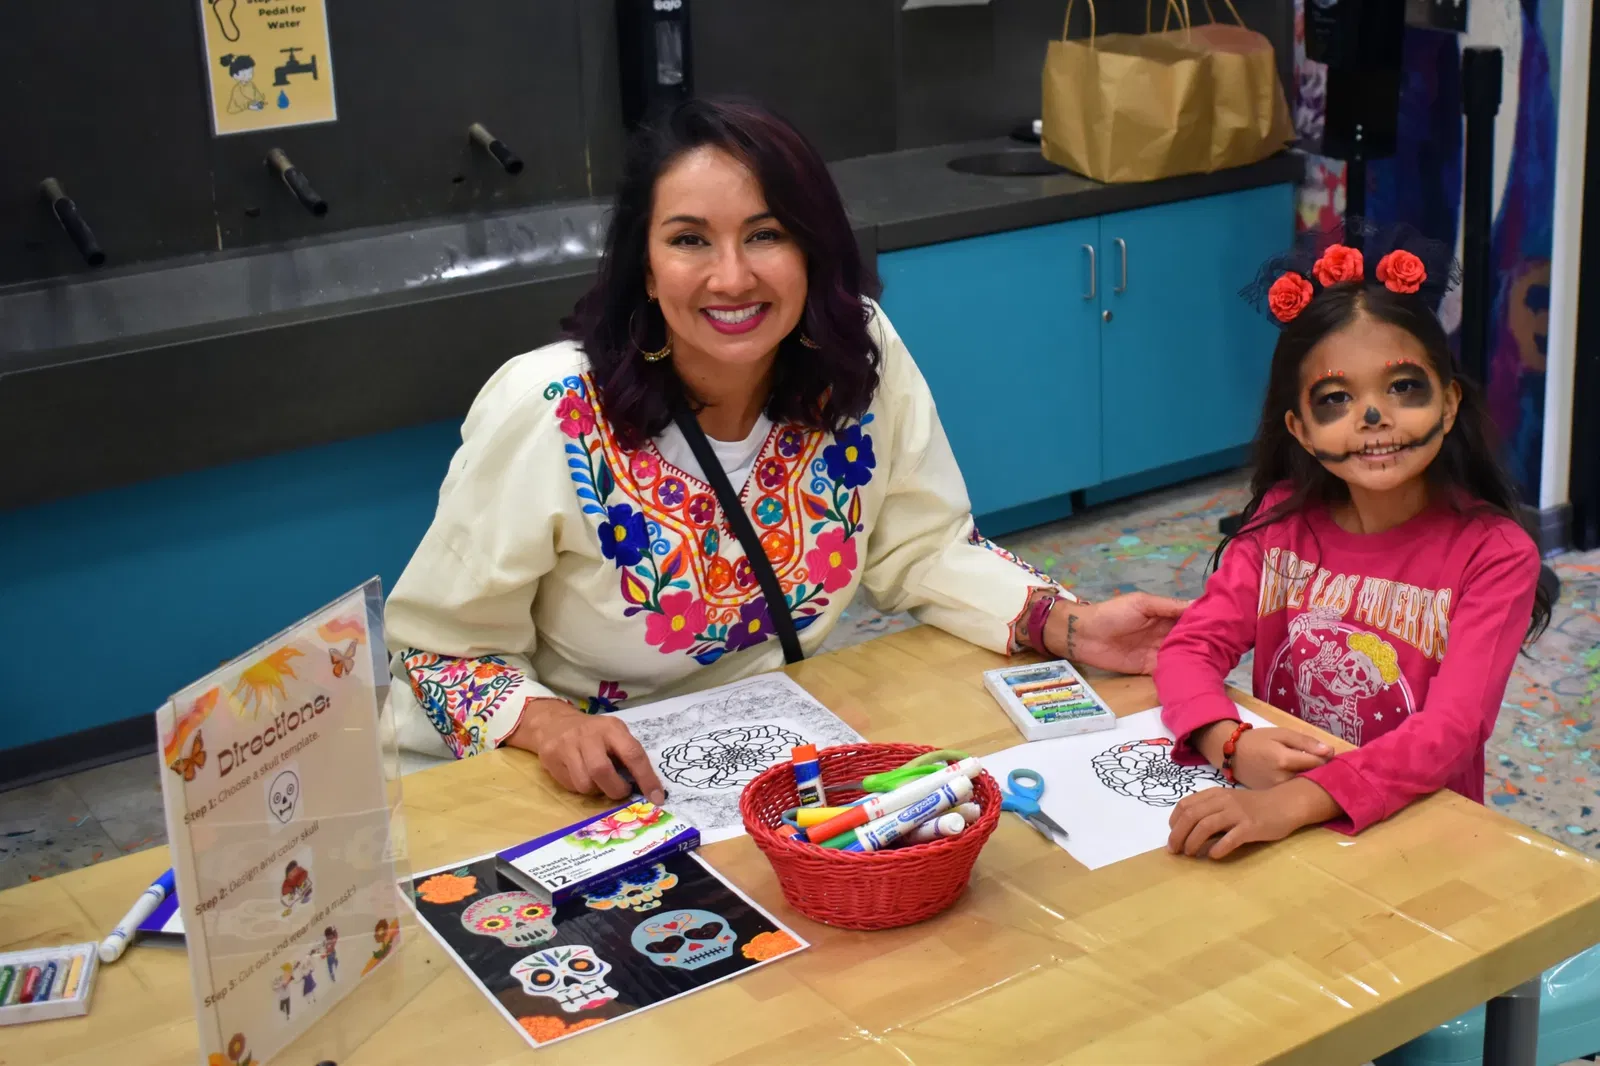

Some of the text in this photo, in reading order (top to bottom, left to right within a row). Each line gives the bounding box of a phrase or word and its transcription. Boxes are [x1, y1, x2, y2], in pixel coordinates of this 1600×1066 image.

[258, 5, 306, 16] Pedal for
[267, 20, 301, 30] Water
[1308, 567, 1361, 617] LOS
[217, 694, 332, 778] Directions:
[183, 731, 321, 826] Step 1: Choose a skull template.
[678, 841, 689, 852] 12
[195, 819, 320, 916] Step 2: Design and color skull
[541, 856, 568, 869] Pastels
[533, 864, 560, 876] Pastels
[538, 865, 573, 880] Crayones
[545, 875, 572, 888] 12
[204, 987, 229, 1007] Step
[238, 968, 255, 983] Cut
[255, 952, 272, 970] out
[271, 939, 289, 957] and
[289, 924, 309, 943] wear
